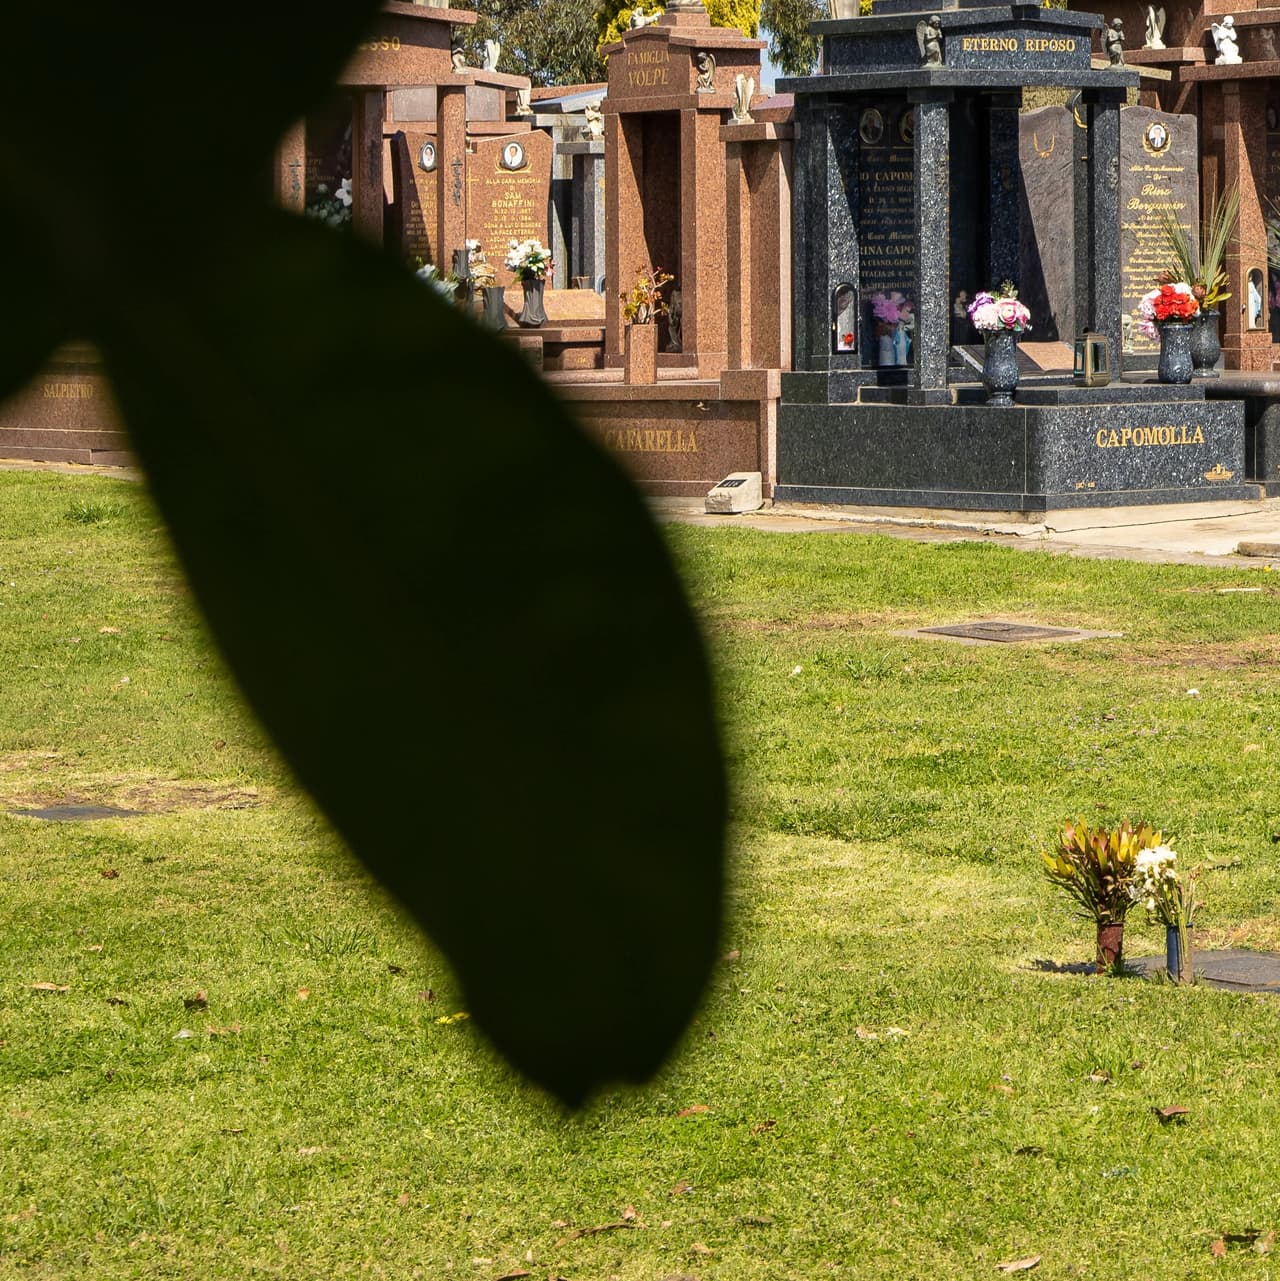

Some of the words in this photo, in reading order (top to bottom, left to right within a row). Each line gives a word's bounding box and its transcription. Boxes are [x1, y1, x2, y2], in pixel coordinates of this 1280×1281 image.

[962, 38, 1018, 51] ETERNO
[1024, 39, 1075, 51] RIPOSO
[627, 50, 670, 65] FAMIGLIA
[628, 67, 670, 86] VOLPE
[504, 192, 522, 200] SAM
[491, 200, 535, 208] BONAFFINI
[1096, 425, 1205, 448] CAPOMOLLA
